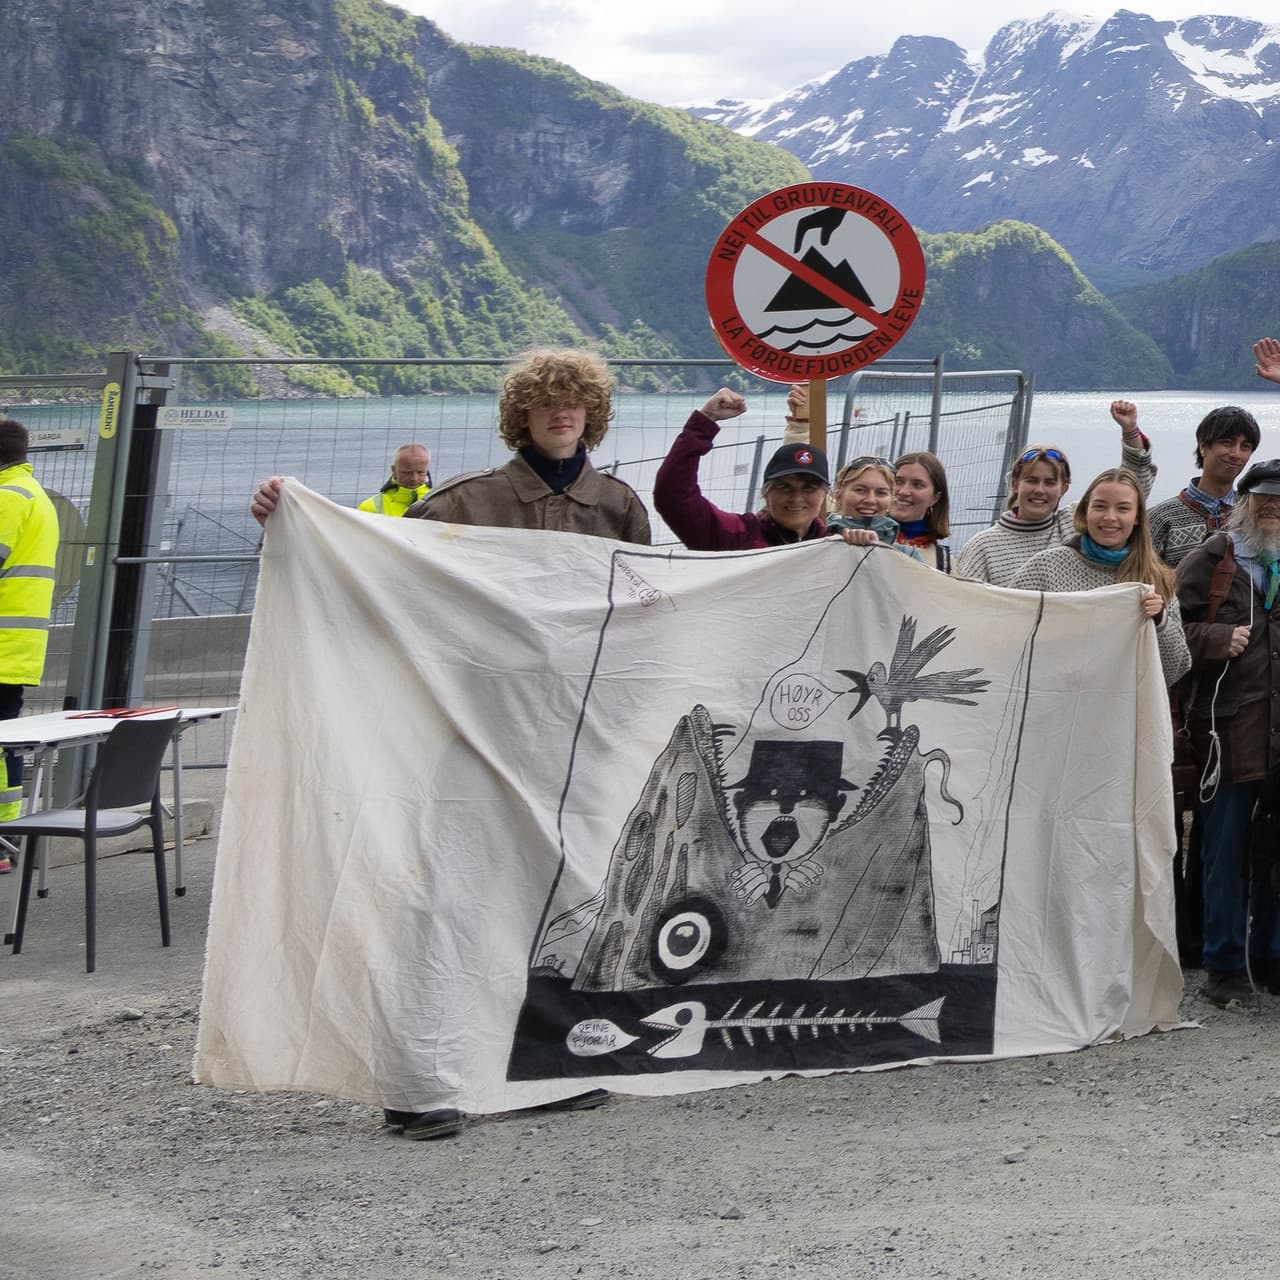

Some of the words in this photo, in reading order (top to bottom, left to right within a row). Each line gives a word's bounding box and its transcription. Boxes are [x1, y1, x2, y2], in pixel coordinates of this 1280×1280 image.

[717, 230, 746, 262] NEI
[741, 207, 774, 233] TIL
[773, 186, 904, 238] GRUVEAVFALL
[721, 316, 738, 340] LA
[741, 331, 894, 375] FØRDEFJORDEN
[893, 287, 920, 332] LEVE
[180, 409, 228, 419] HELDAL
[780, 684, 823, 706] HØYR
[788, 707, 811, 722] OSS
